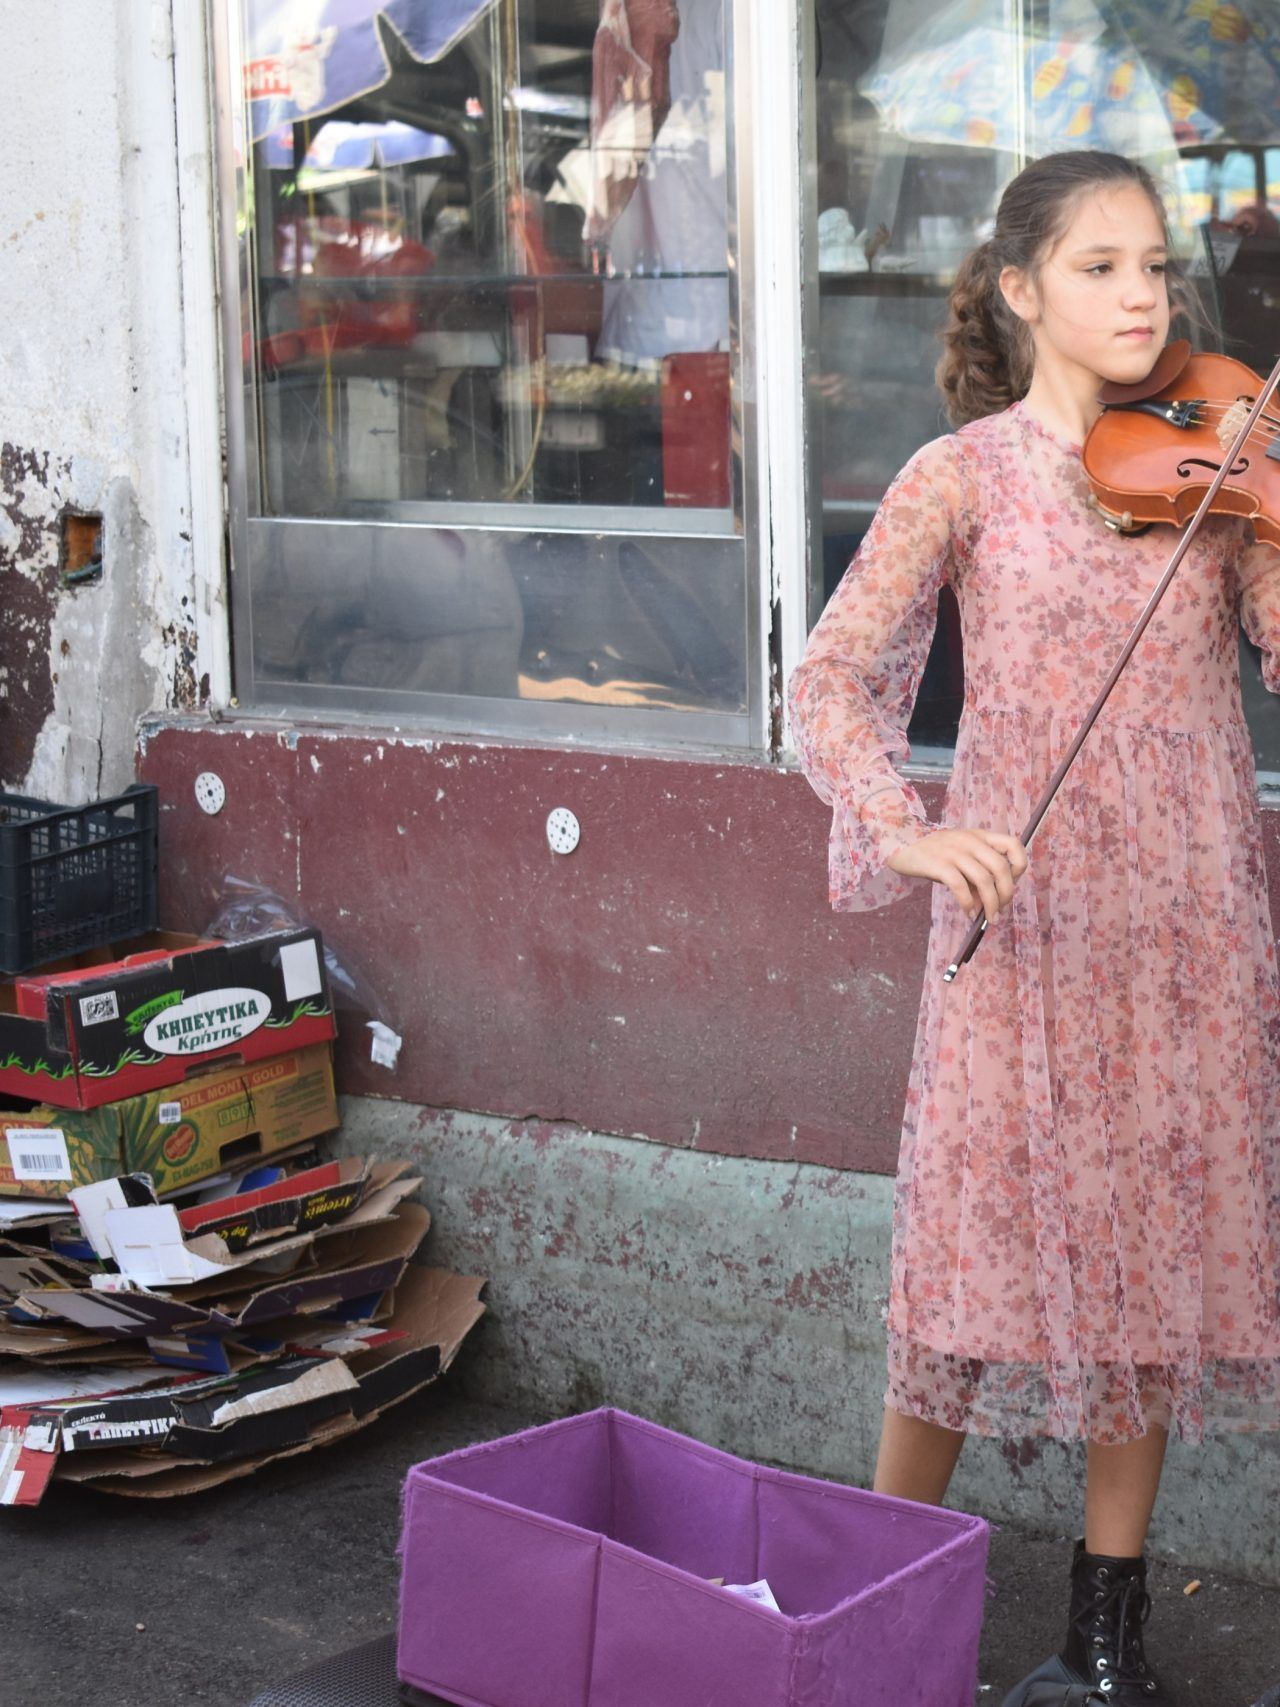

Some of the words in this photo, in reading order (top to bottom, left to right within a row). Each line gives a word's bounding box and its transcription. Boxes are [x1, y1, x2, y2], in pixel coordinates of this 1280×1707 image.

[156, 999, 259, 1041] ΚΗΠΕΥΤΙΚΑ
[181, 1091, 206, 1109] DEL
[252, 1063, 285, 1084] GOLD
[305, 1195, 353, 1220] Artemis
[231, 1226, 248, 1238] Top
